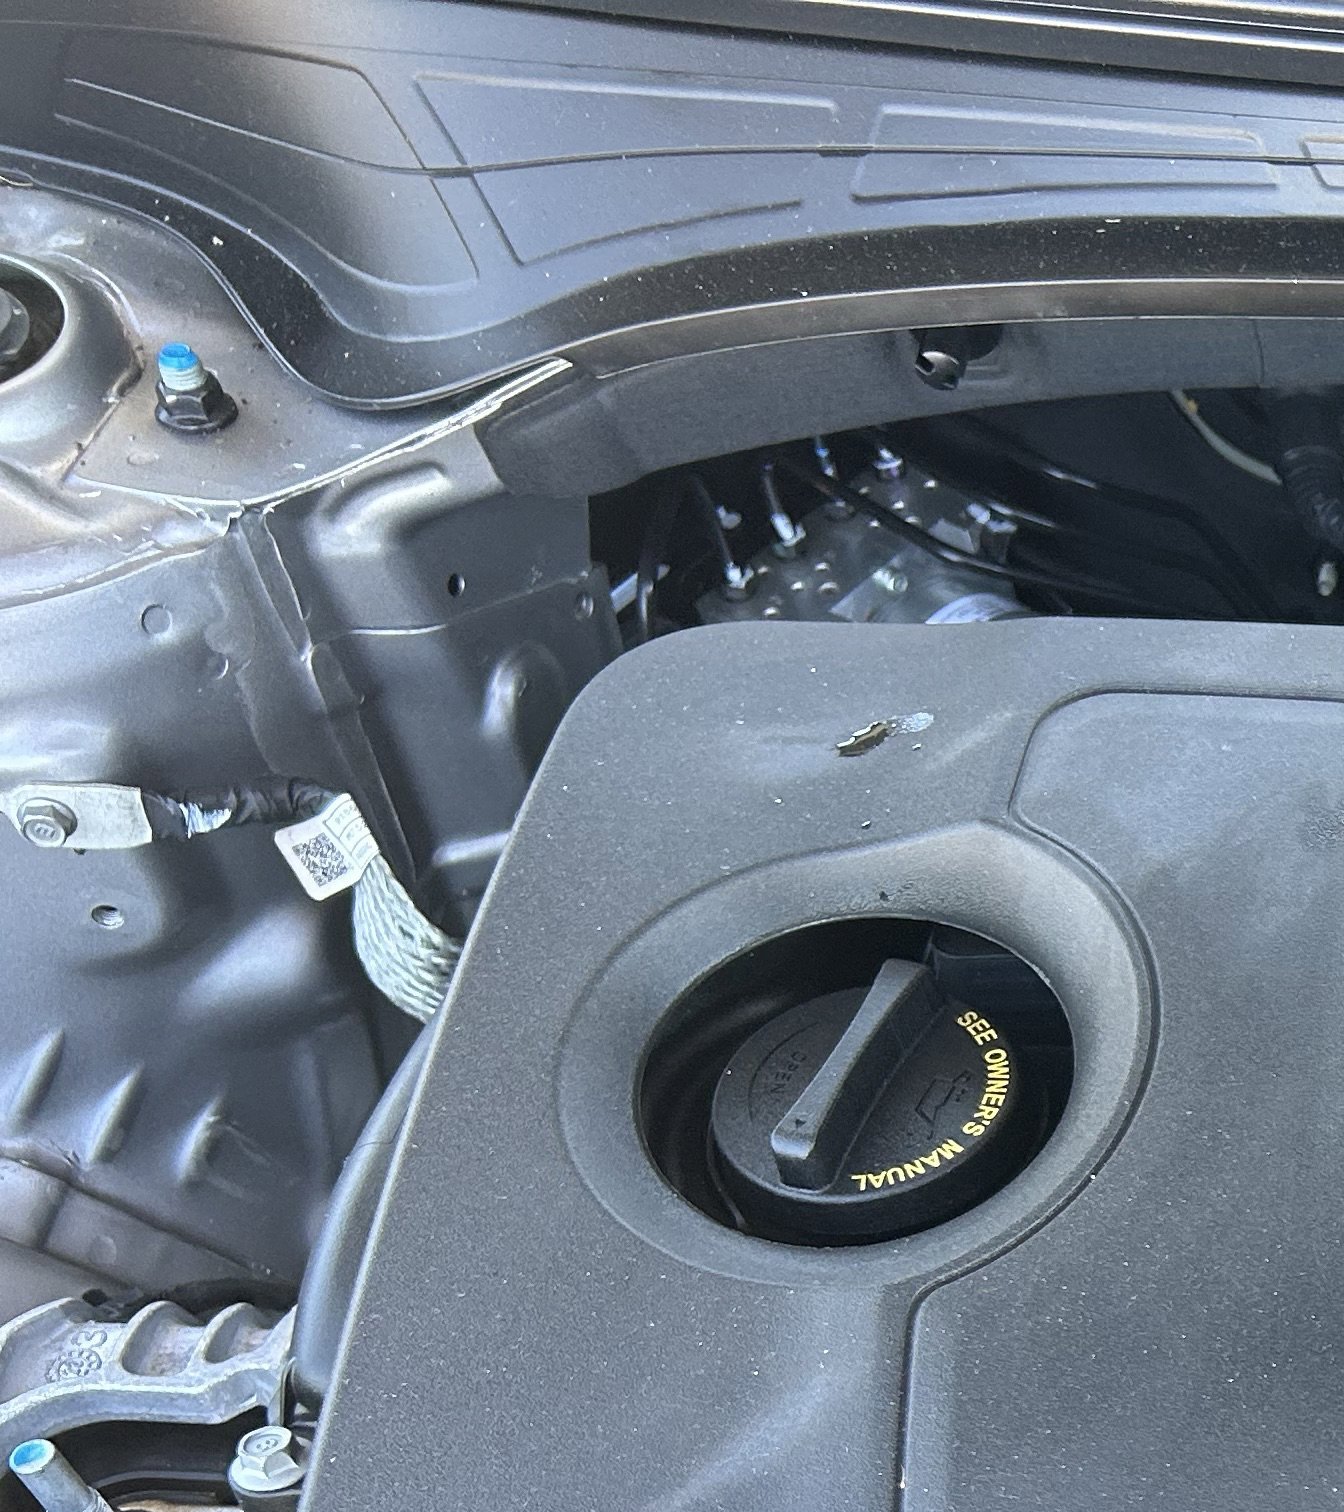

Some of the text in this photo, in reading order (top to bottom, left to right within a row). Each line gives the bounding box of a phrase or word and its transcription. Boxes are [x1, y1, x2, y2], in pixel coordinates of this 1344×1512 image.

[849, 1010, 1012, 1192] SEE OWNER'S MANUAL
